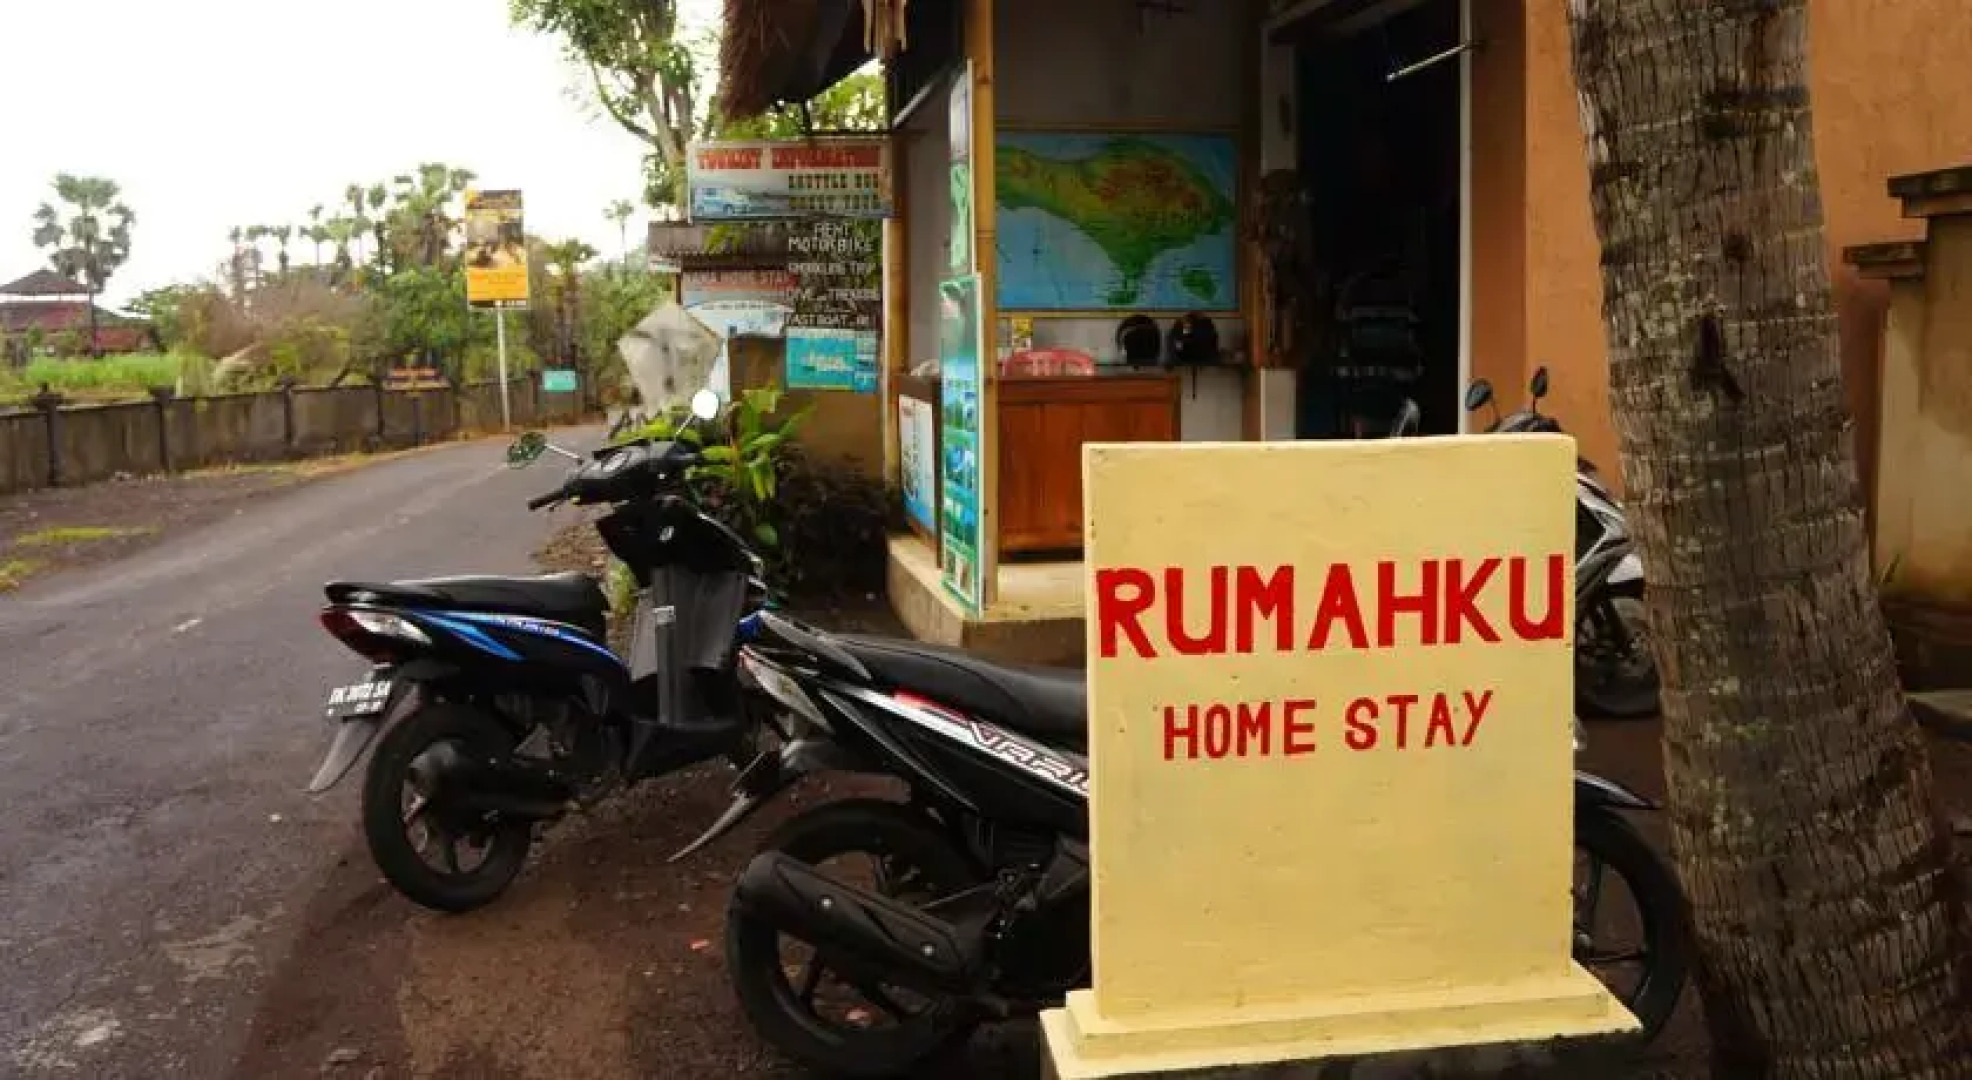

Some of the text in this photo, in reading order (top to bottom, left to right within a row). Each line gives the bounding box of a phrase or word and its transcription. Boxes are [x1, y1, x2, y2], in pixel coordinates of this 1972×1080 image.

[788, 236, 874, 252] MOTORBIKE
[1096, 554, 1565, 659] RUMAHKU
[1164, 690, 1493, 761] HOME STAY
